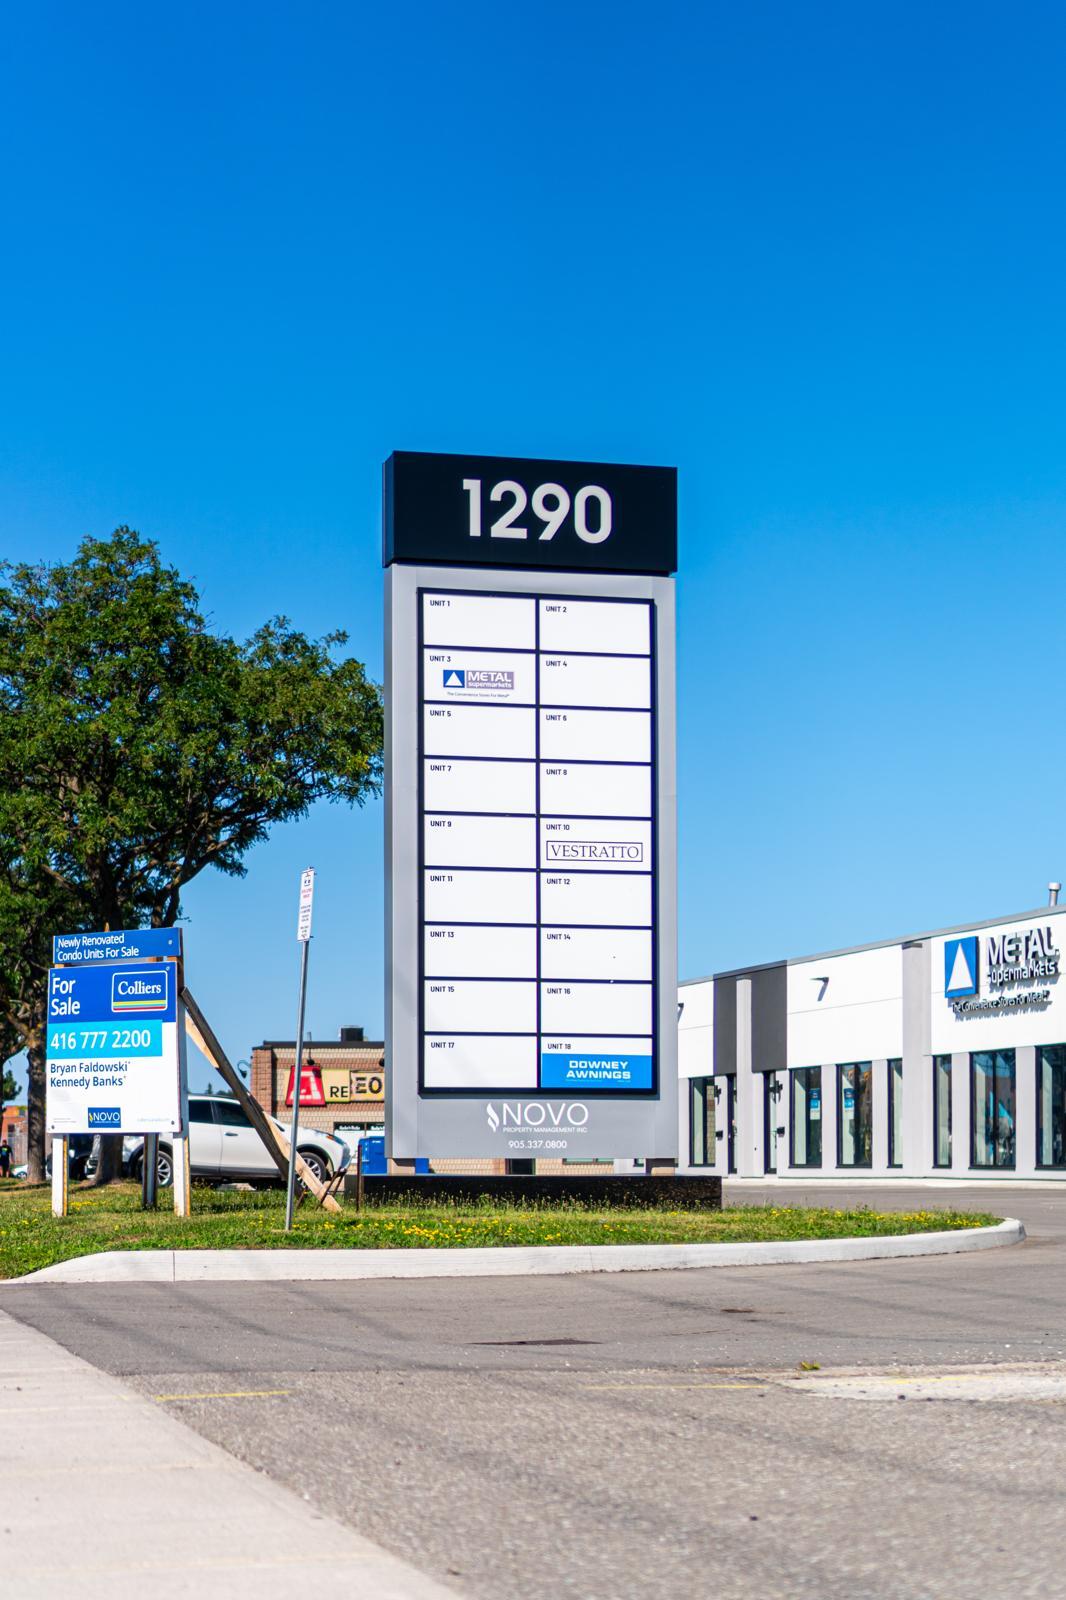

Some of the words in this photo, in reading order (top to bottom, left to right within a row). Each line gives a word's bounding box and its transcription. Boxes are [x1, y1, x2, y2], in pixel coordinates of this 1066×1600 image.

[463, 479, 611, 544] 1290
[468, 672, 511, 682] METAL
[551, 844, 639, 858] VESTRATTO
[58, 938, 81, 950] Newly
[82, 933, 124, 946] Renovated
[58, 950, 82, 961] Condo
[84, 948, 104, 959] Units
[106, 948, 118, 957] For
[121, 946, 139, 957] Sale
[52, 978, 76, 994] For
[118, 981, 161, 995] Colliers
[51, 997, 80, 1016] Sale
[51, 1032, 76, 1049] 416
[80, 1031, 108, 1048] 777
[112, 1030, 151, 1048] 2200
[50, 1064, 76, 1076] Bryan
[569, 1060, 628, 1069] DOWNEY
[566, 1070, 631, 1079] AWNINGS
[50, 1076, 90, 1089] Kennedy
[93, 1112, 120, 1121] NOVO
[503, 1103, 589, 1126] NOVO
[508, 1140, 567, 1149] 905.337.0800
